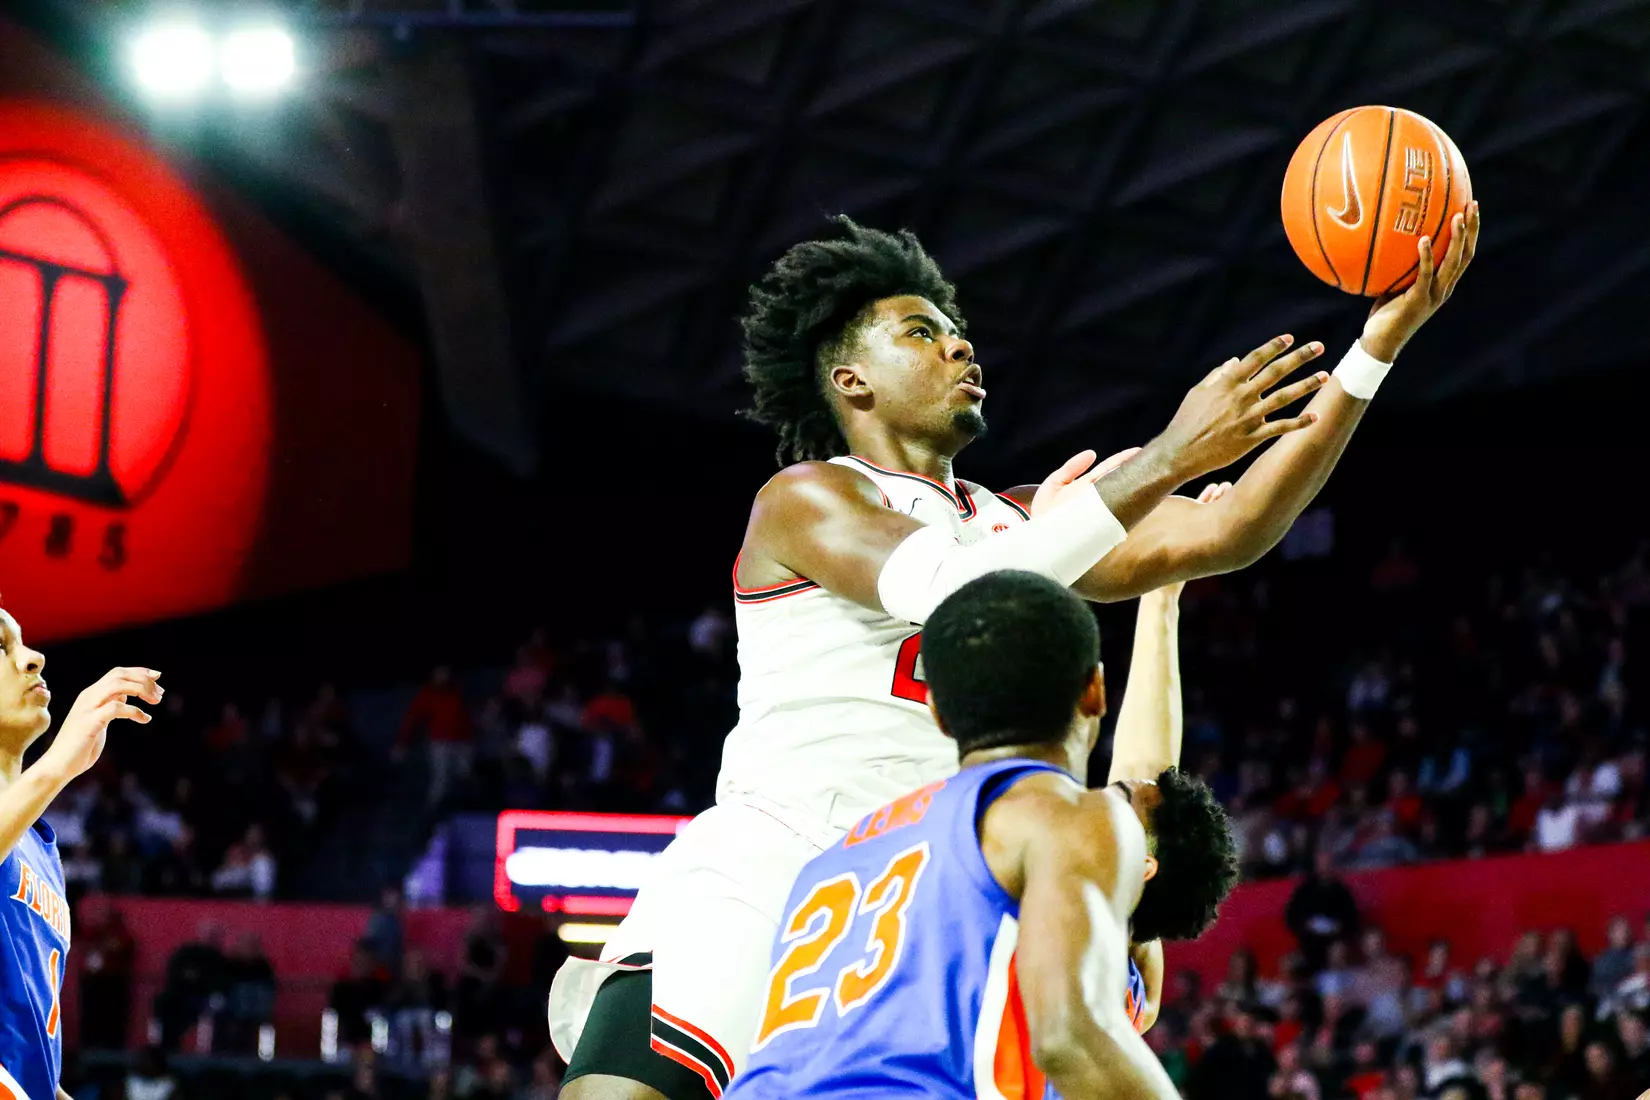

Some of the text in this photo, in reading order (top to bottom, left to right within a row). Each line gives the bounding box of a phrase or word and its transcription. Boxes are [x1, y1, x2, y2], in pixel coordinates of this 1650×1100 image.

[1394, 147, 1428, 235] ELITE
[10, 859, 71, 944] FLORI
[749, 841, 932, 1054] 23
[46, 948, 61, 1039] 1
